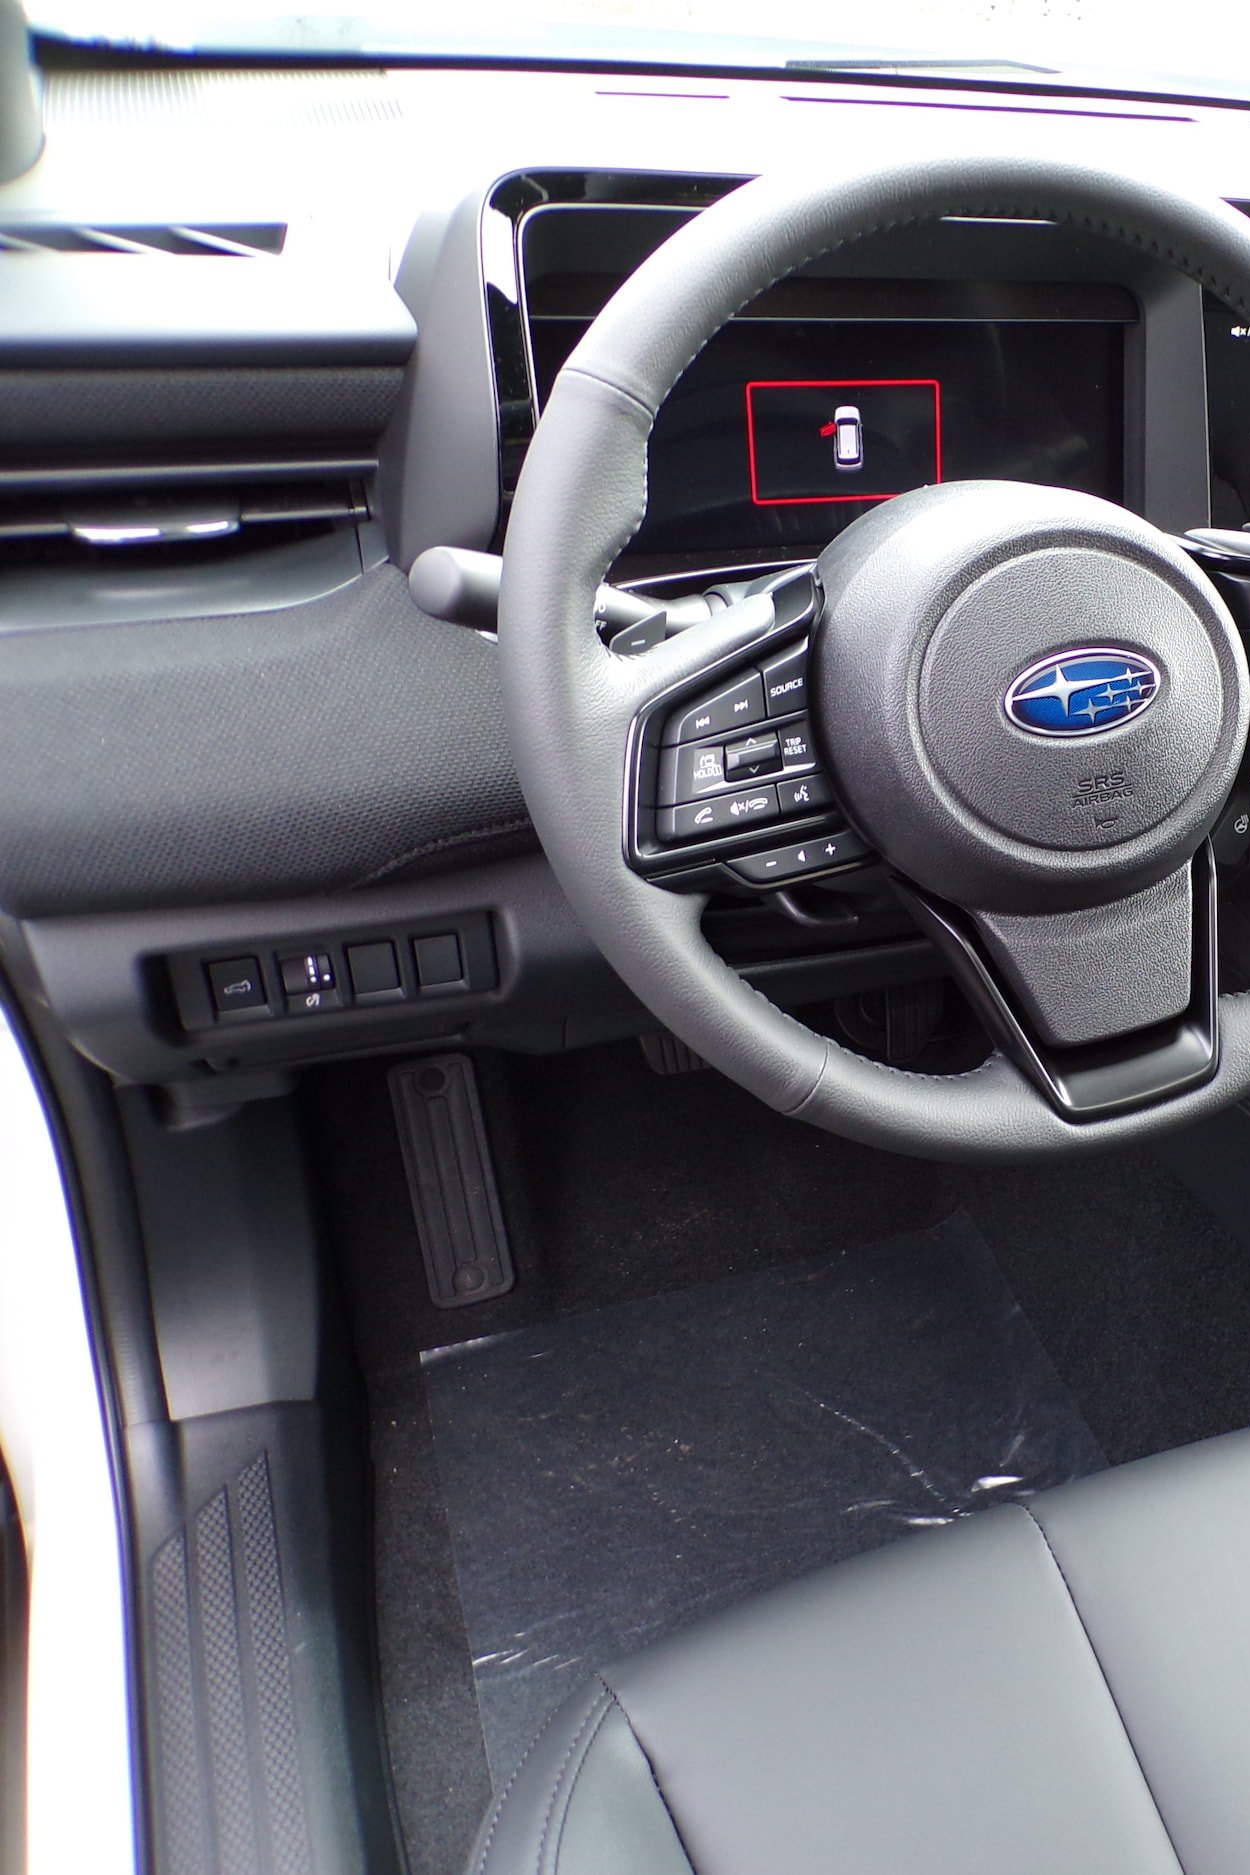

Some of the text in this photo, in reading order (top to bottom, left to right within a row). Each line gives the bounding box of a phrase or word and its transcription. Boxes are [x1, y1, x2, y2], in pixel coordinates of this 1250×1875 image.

[770, 677, 803, 697] SOURCE
[784, 744, 807, 755] RESET
[786, 737, 802, 746] TRIP
[1078, 773, 1125, 793] SRS
[1072, 788, 1134, 808] AIRBAG
